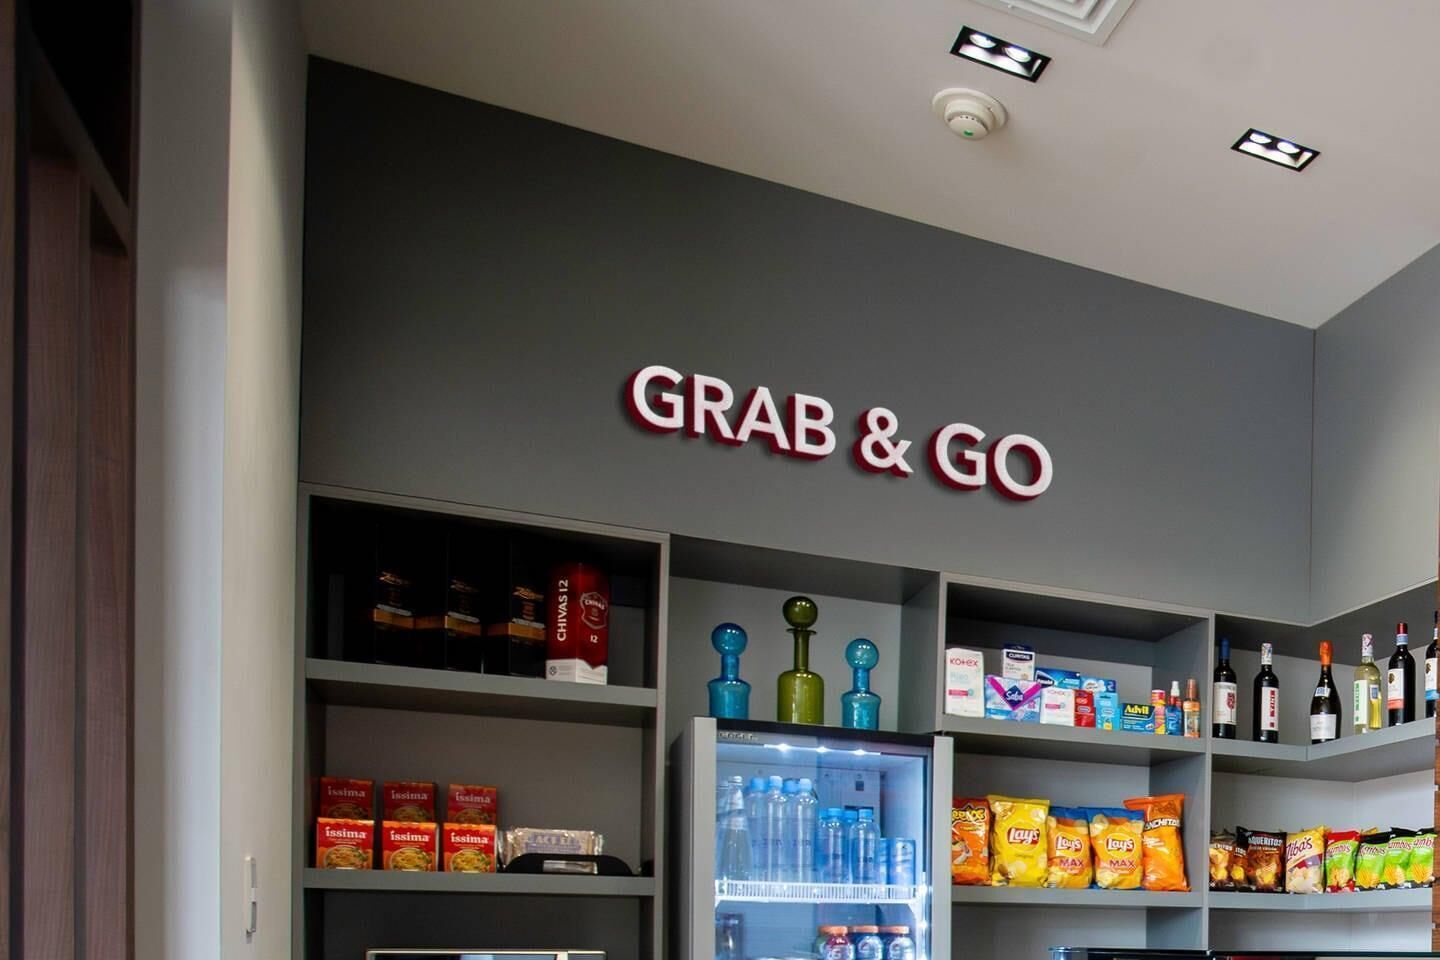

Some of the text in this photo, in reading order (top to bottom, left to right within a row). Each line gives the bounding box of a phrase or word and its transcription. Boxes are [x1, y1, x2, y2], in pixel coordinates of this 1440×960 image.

[629, 365, 1053, 499] GRAB & GO
[557, 579, 569, 641] CHIVAS 12
[1124, 704, 1149, 715] Advil
[1144, 817, 1180, 831] ANCHITAS
[1060, 858, 1083, 867] MAX
[1109, 859, 1135, 868] MAX
